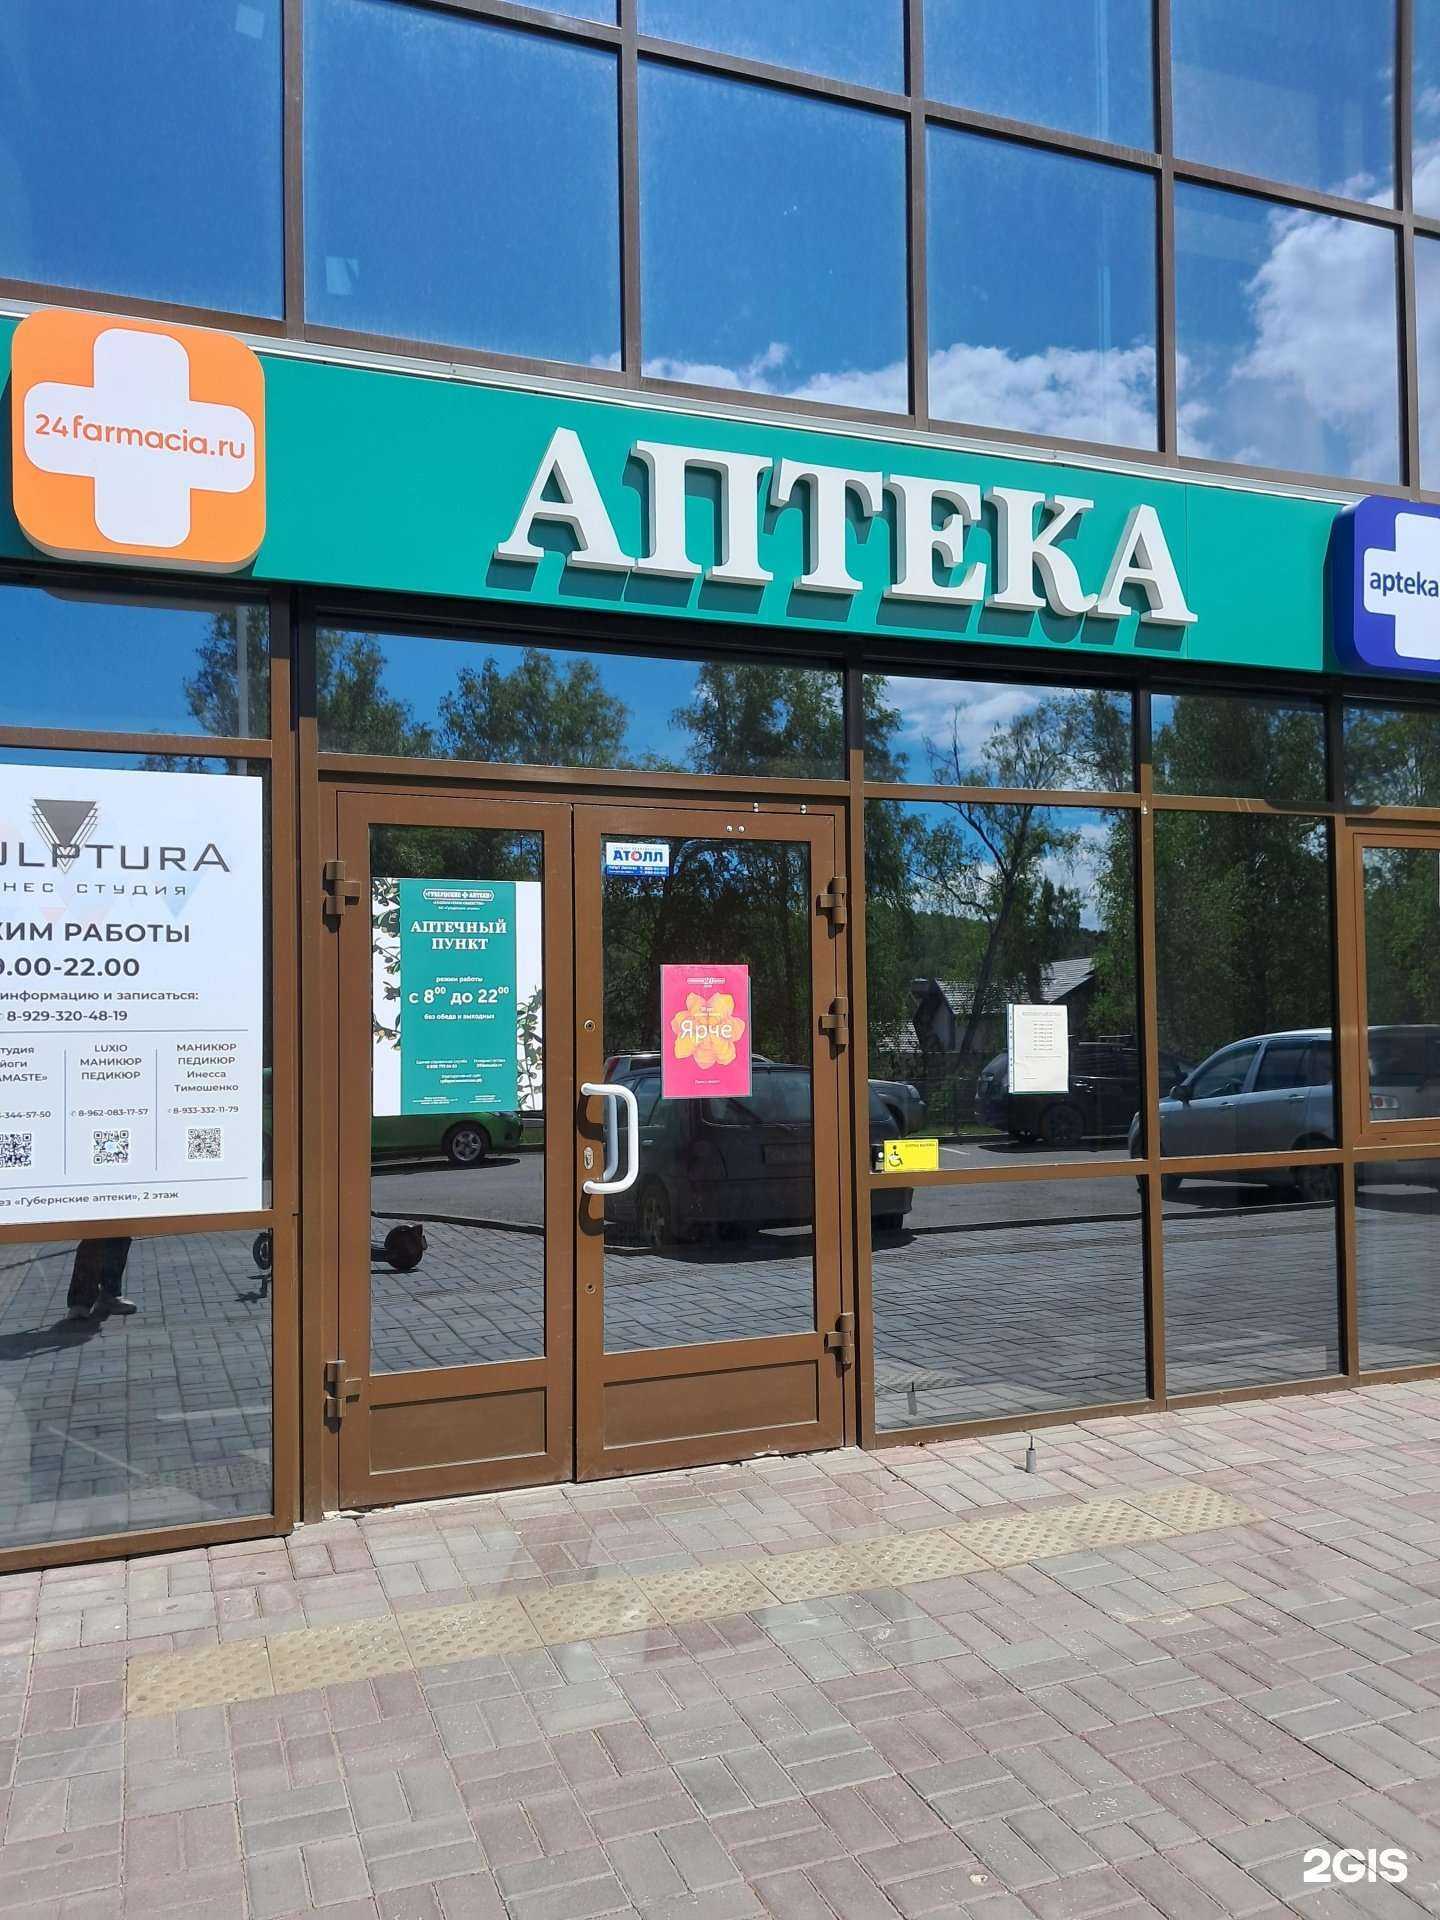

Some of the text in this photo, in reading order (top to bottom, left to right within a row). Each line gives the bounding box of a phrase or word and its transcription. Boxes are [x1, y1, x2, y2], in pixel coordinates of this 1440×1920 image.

[35, 413, 246, 459] 24farmacia.ru
[493, 426, 1198, 624] АПТЕКА
[1370, 571, 1439, 598] apteka
[0, 841, 231, 872] LPTURA
[76, 883, 187, 896] СТУДИЯ
[0, 921, 190, 943] ИМ РАБОТЫ
[411, 918, 507, 934] АПТЕЧНЫЙ
[431, 938, 489, 950] ПУНКТ
[0, 957, 140, 977] .00-22.00
[0, 990, 199, 1003] информацию и записаться:
[450, 992, 473, 1006] до
[7, 1010, 128, 1022] 8-929-320-48-19
[681, 1019, 732, 1044] Ярче
[94, 1044, 128, 1052] LUXIO
[176, 1043, 237, 1052] МАНИКЮР
[80, 1058, 142, 1066] МАНИКЮР
[177, 1056, 236, 1066] ПЕДИКЮР
[0, 1073, 48, 1082] MASTE»
[81, 1071, 141, 1081] ПЕДИКЮР
[187, 1070, 226, 1078] Инесса
[174, 1083, 239, 1093] Тимошенко
[15, 1195, 90, 1207] «Губернские
[143, 1192, 149, 1200] 2
[152, 1191, 179, 1201] этаж
